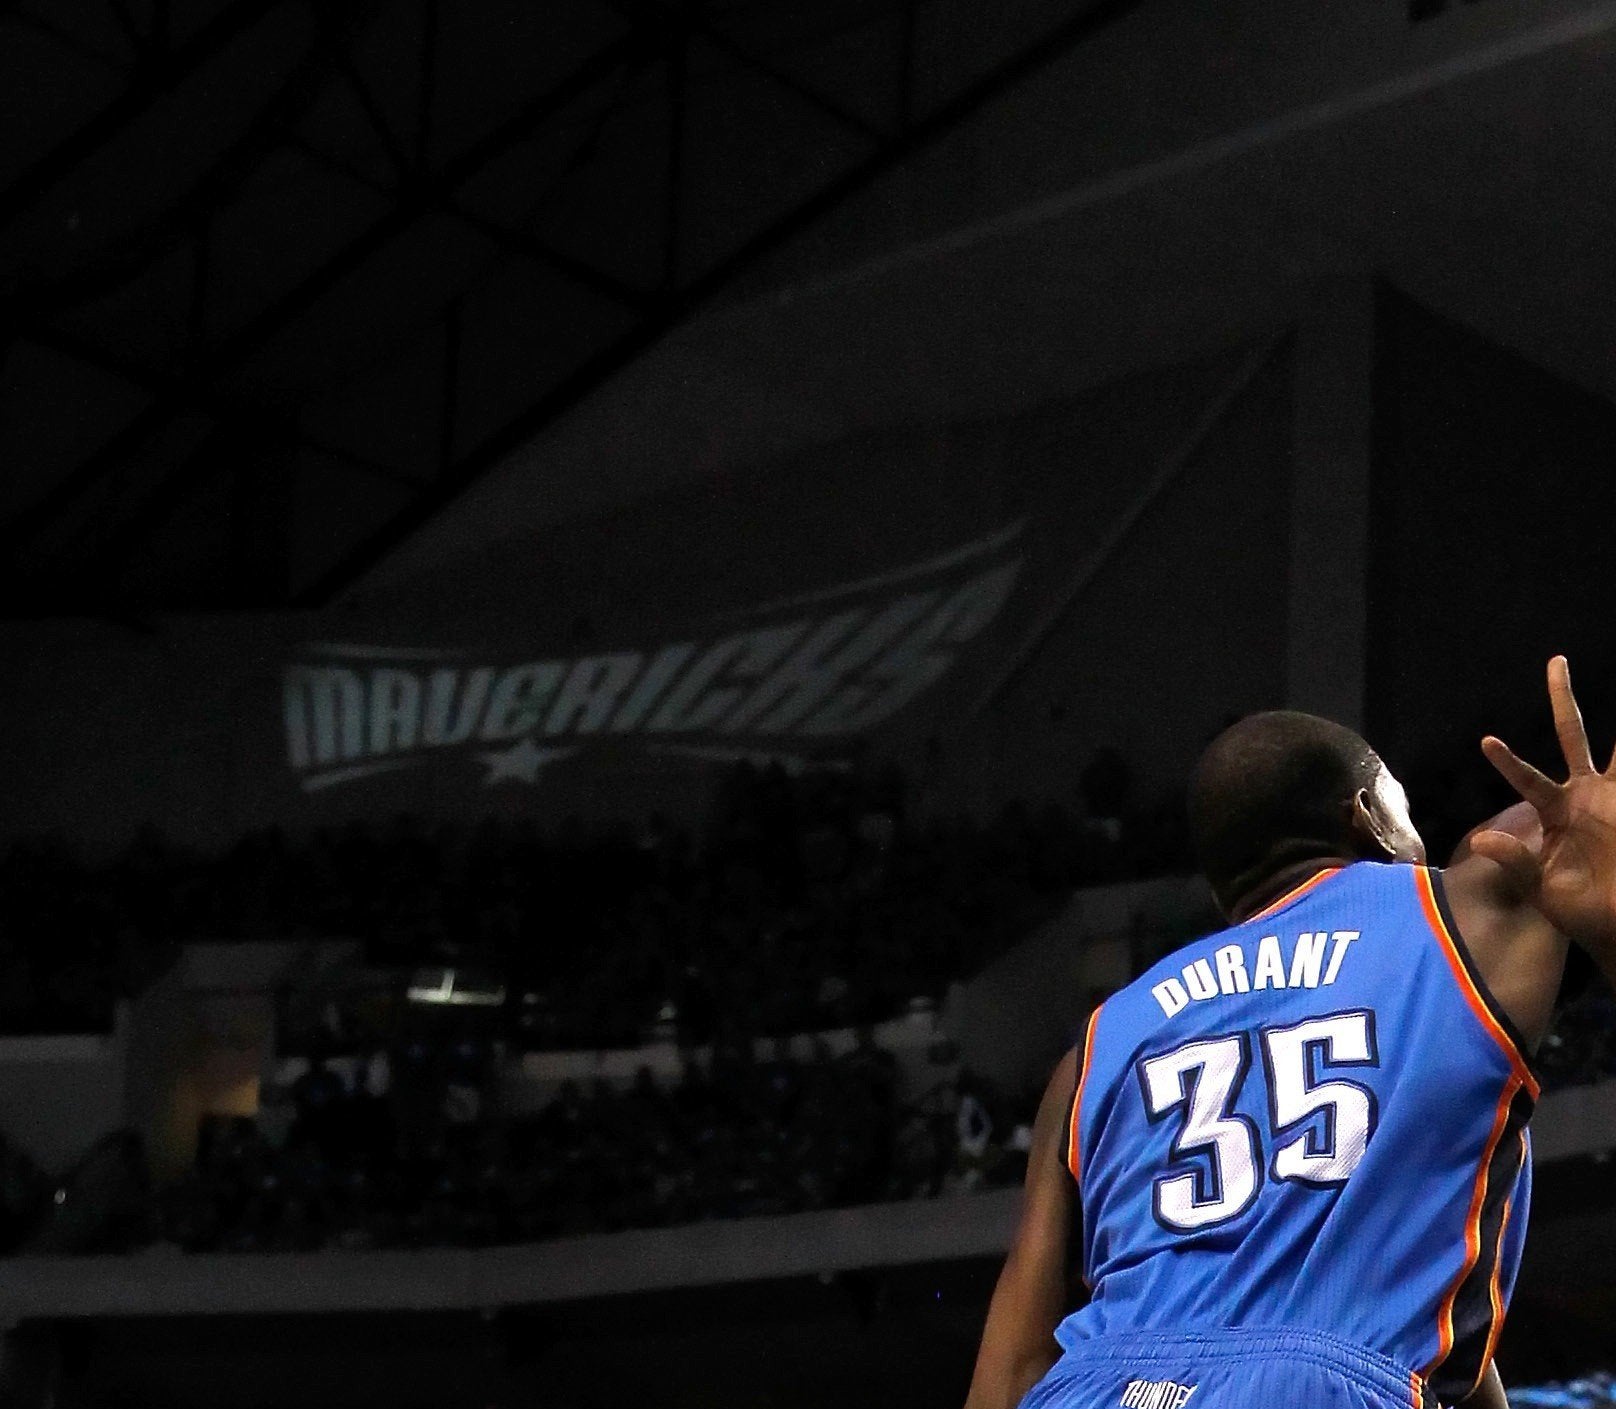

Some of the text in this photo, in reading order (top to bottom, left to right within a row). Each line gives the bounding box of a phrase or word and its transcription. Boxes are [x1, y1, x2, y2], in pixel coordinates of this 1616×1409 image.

[282, 556, 1025, 768] MAVERICKS
[1151, 930, 1361, 1019] DURANT
[1137, 1007, 1379, 1235] 35
